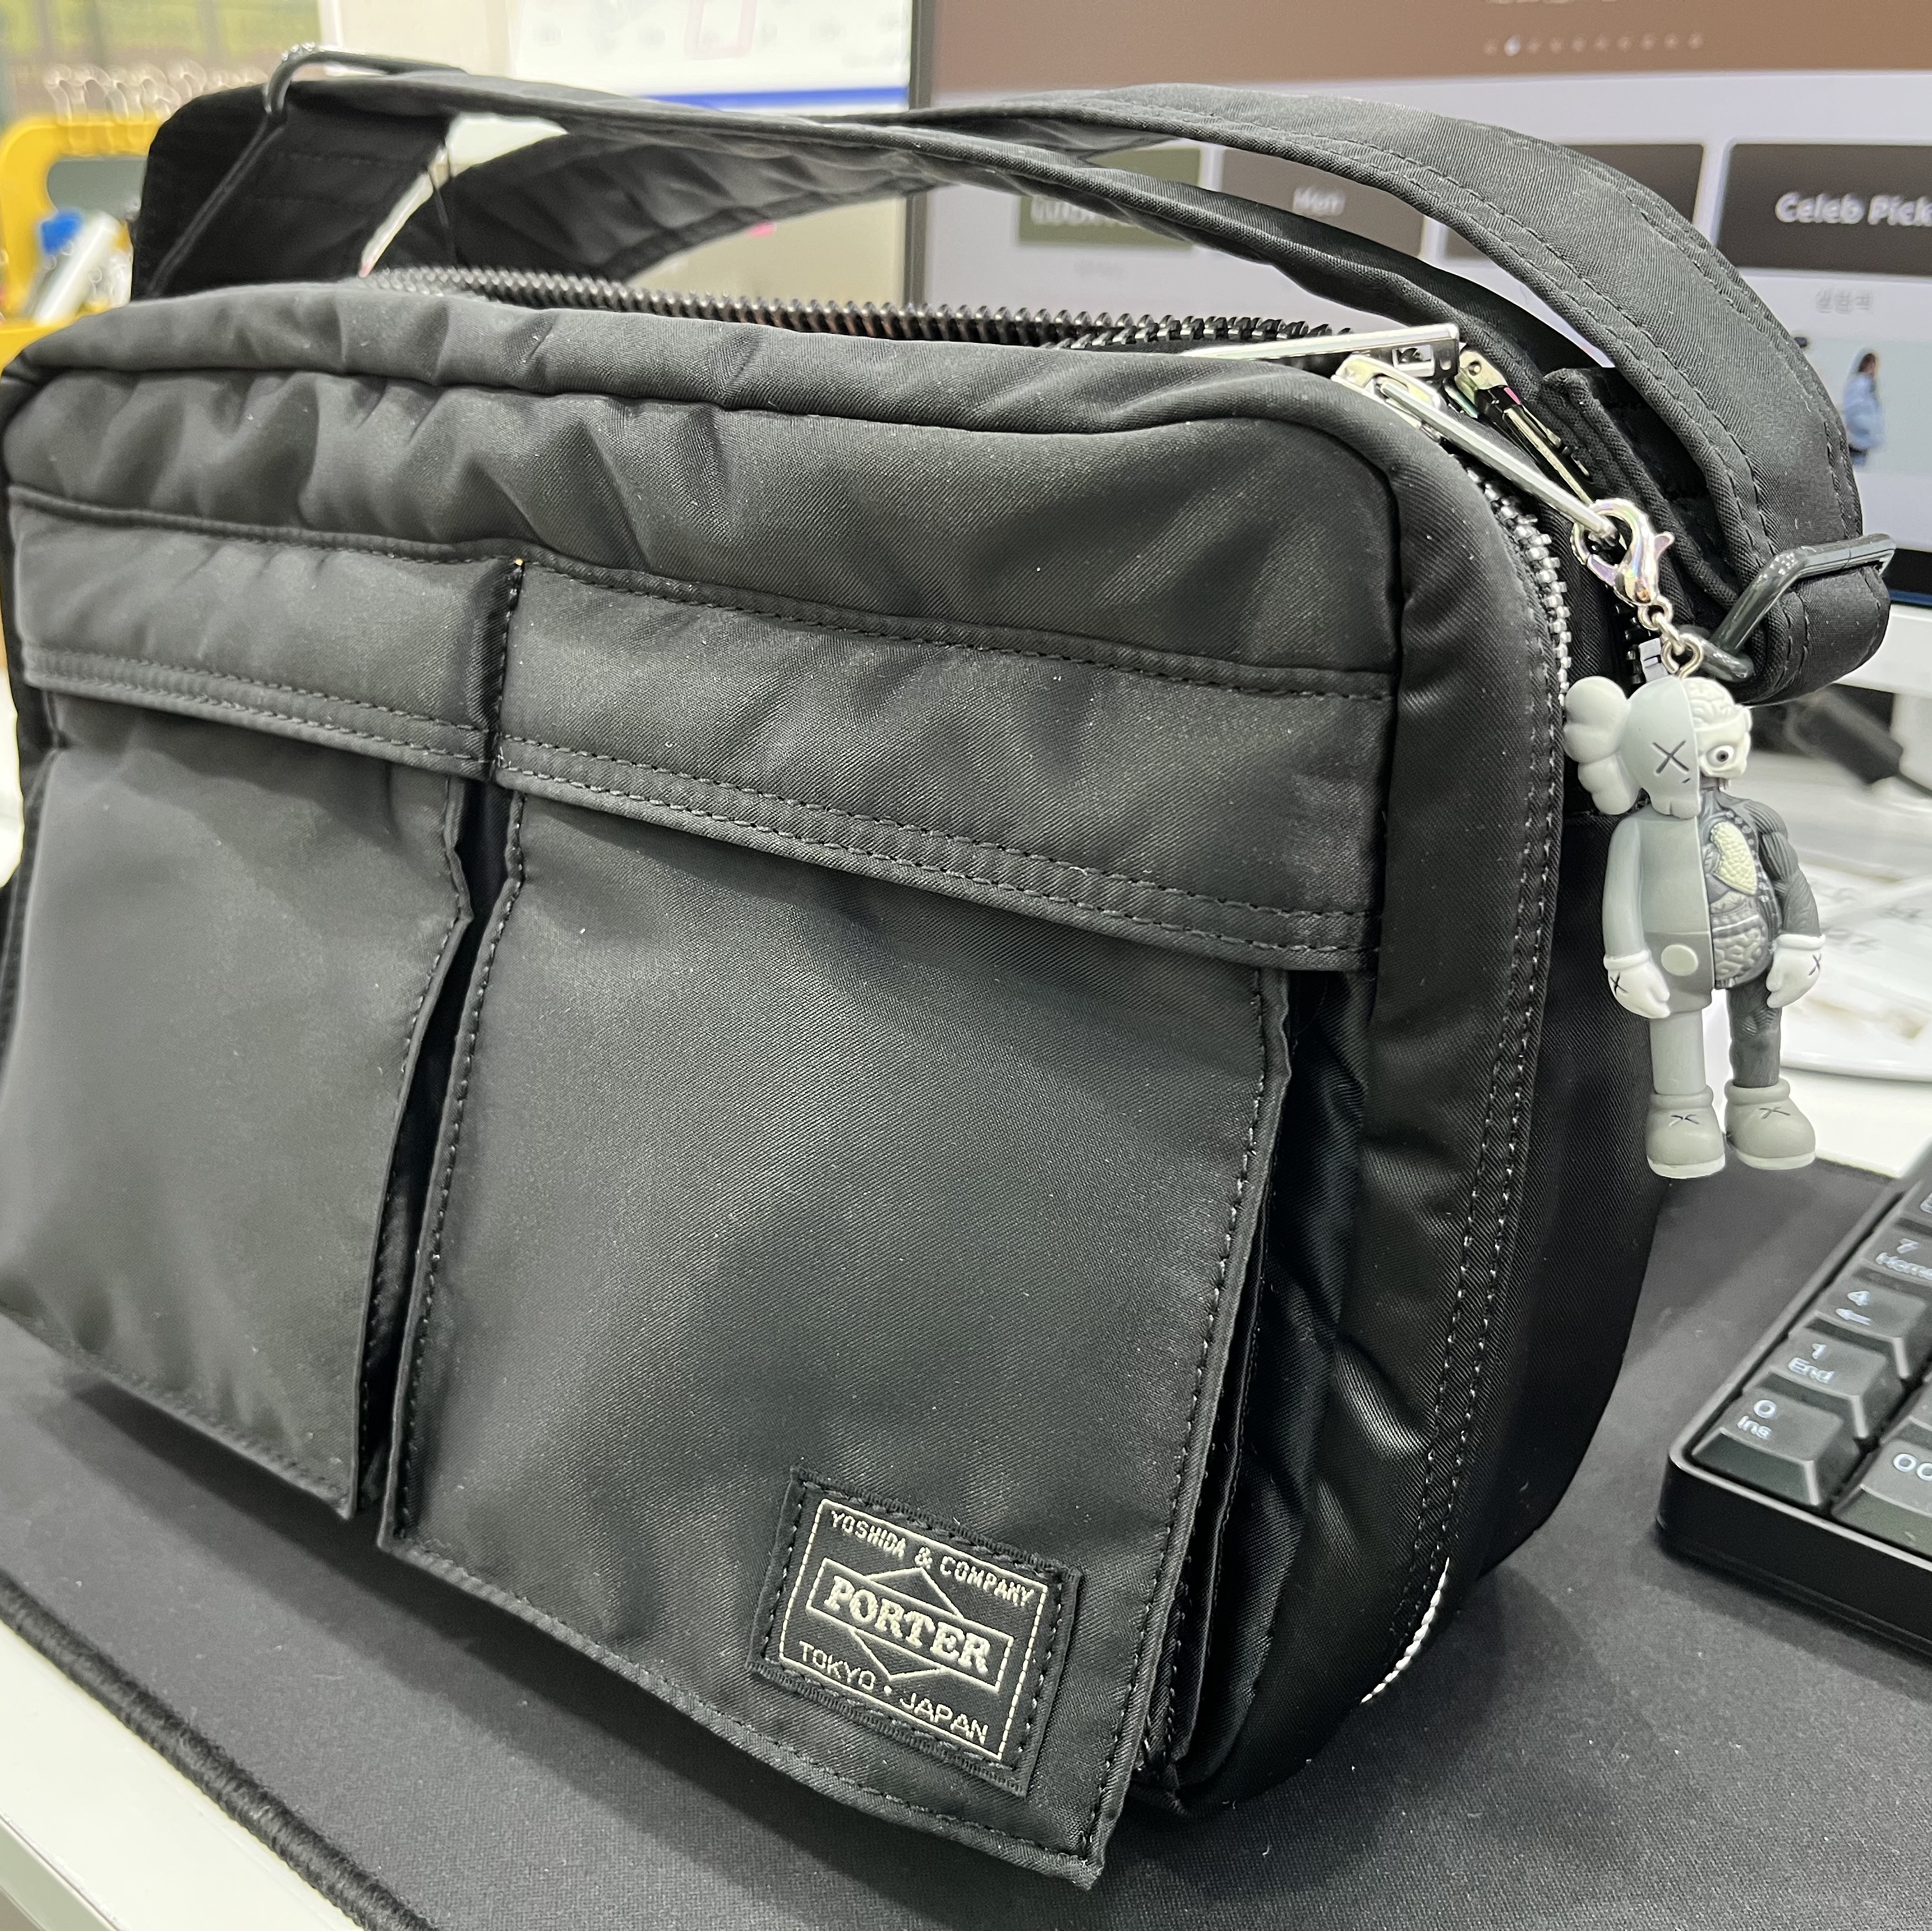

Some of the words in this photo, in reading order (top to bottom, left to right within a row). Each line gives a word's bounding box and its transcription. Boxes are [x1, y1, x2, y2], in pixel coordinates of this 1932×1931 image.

[1775, 192, 1865, 224] Celeb
[1897, 1238, 1919, 1254] 7
[1848, 1291, 1871, 1306] 4
[1812, 1343, 1827, 1359] 1
[1788, 1358, 1834, 1384] End
[1754, 1400, 1777, 1418] 0
[1737, 1416, 1772, 1439] Ins
[832, 1510, 906, 1558] YOSHIDA
[915, 1547, 932, 1570] &
[939, 1556, 1035, 1607] COMPANY
[824, 1575, 991, 1674] PORTER
[799, 1640, 876, 1691] TOKYO
[899, 1692, 988, 1745] JAPAN
